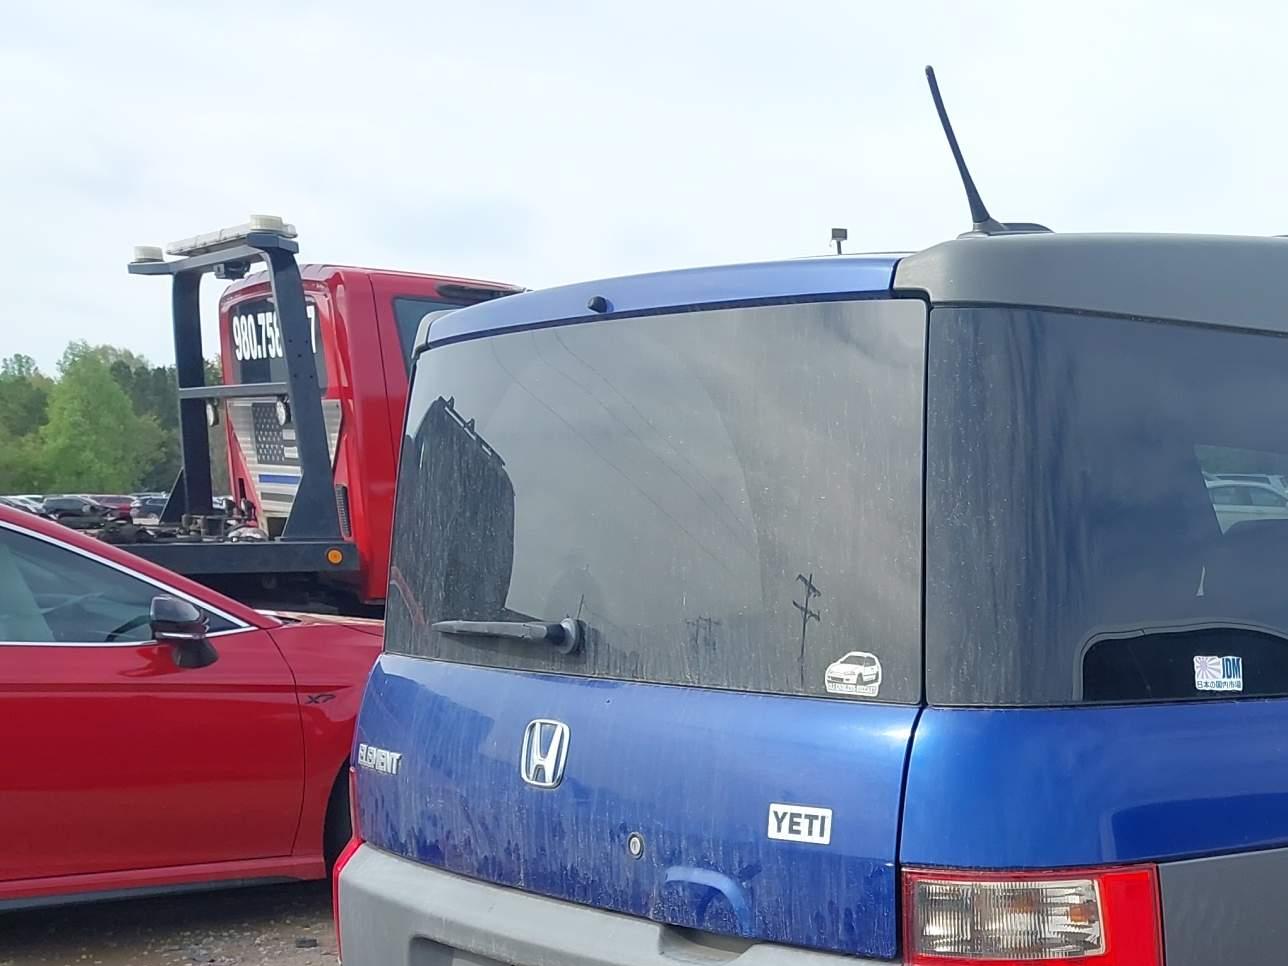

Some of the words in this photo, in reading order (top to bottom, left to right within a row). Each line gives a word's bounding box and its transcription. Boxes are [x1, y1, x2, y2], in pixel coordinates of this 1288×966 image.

[1221, 657, 1241, 679] JDM
[358, 743, 402, 775] ELEMENT
[773, 810, 826, 838] YETI
